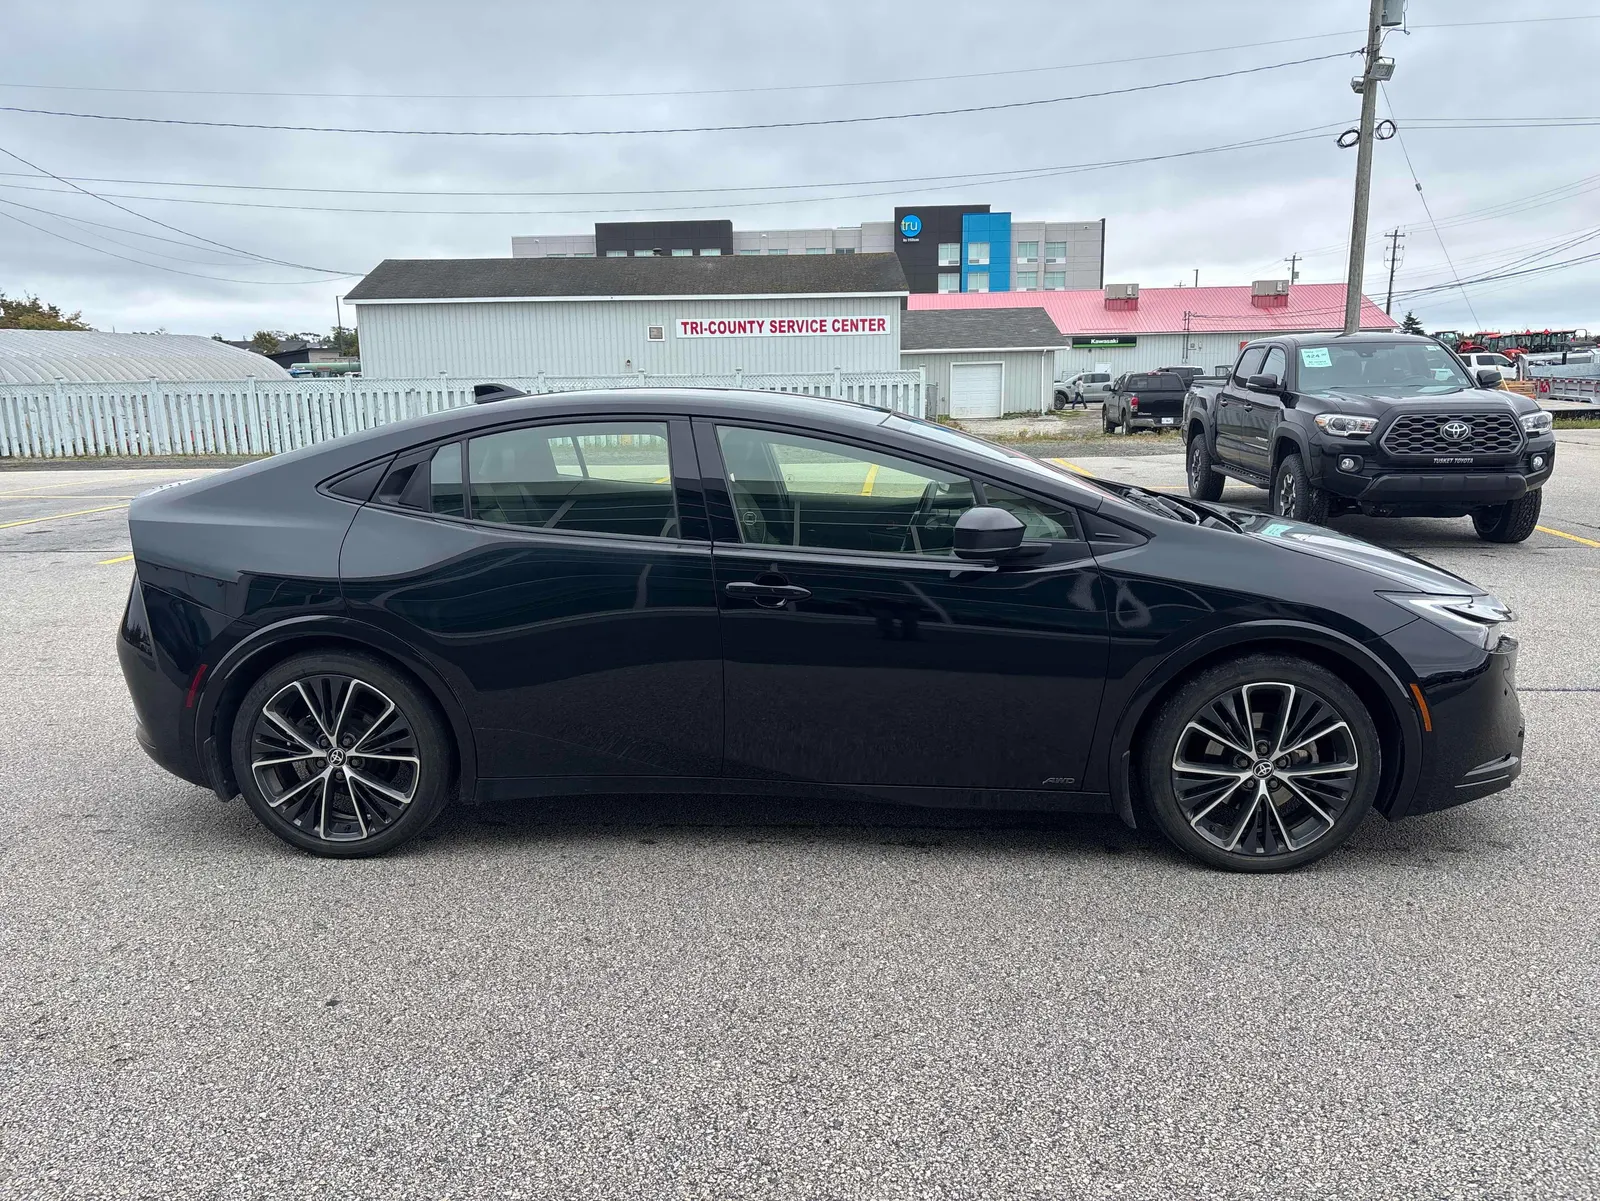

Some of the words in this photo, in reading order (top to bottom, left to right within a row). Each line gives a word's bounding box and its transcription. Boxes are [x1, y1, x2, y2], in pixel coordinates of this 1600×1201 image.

[901, 220, 918, 231] tru
[681, 320, 765, 335] TRI-COUNTY
[769, 319, 828, 334] SERVICE
[831, 318, 886, 333] CENTER
[1042, 777, 1075, 785] AWD
